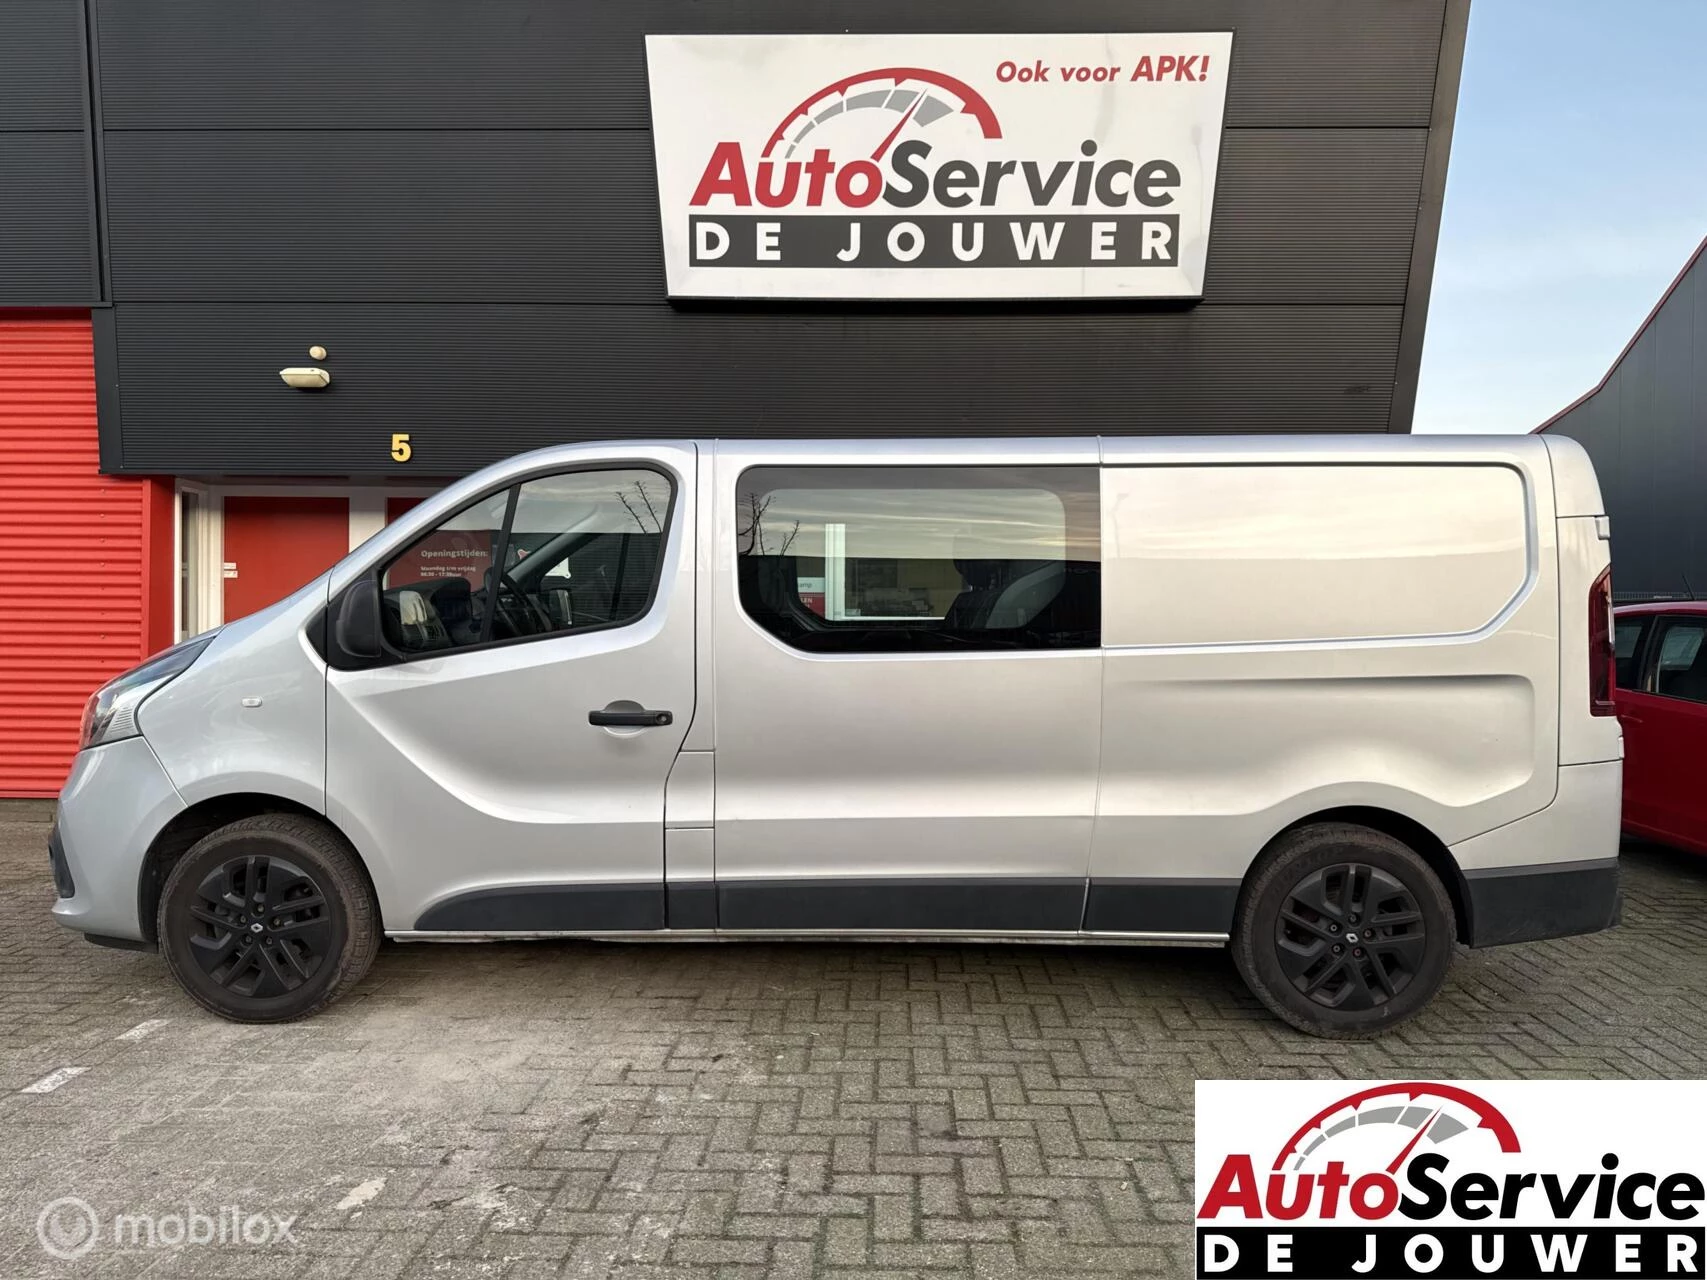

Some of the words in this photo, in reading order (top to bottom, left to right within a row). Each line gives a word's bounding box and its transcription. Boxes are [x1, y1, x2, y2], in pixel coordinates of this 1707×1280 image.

[996, 60, 1049, 83] Ook
[1060, 66, 1120, 82] voor
[1131, 55, 1210, 82] APK!
[689, 139, 1181, 208] AutoService
[696, 221, 781, 261] DE
[836, 221, 1172, 262] JOUWER
[391, 433, 412, 462] 5
[421, 550, 488, 558] Openingstijden:
